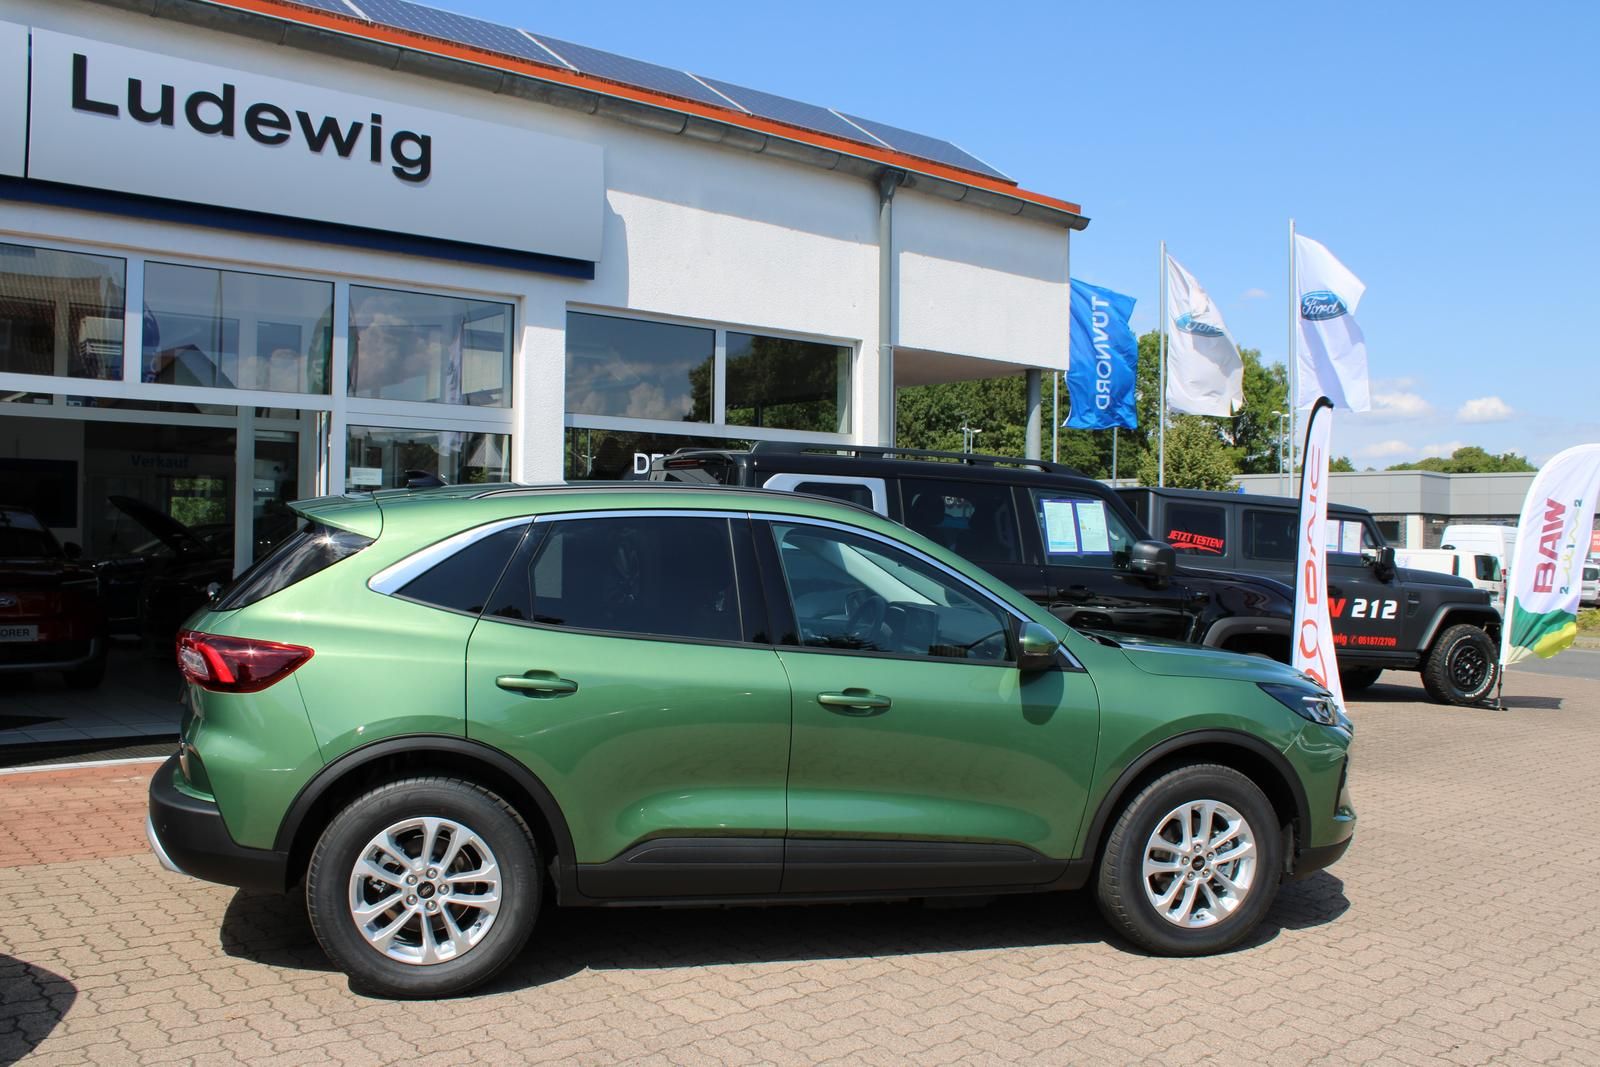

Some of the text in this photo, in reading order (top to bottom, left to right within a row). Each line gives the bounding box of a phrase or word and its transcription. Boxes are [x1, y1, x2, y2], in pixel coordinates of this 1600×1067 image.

[72, 53, 431, 182] Ludewig
[1302, 295, 1339, 315] Ford
[129, 453, 190, 469] Verkauf
[1167, 529, 1225, 549] JETZT TESTEN!
[1532, 497, 1567, 594] BAW
[1351, 598, 1398, 620] 212
